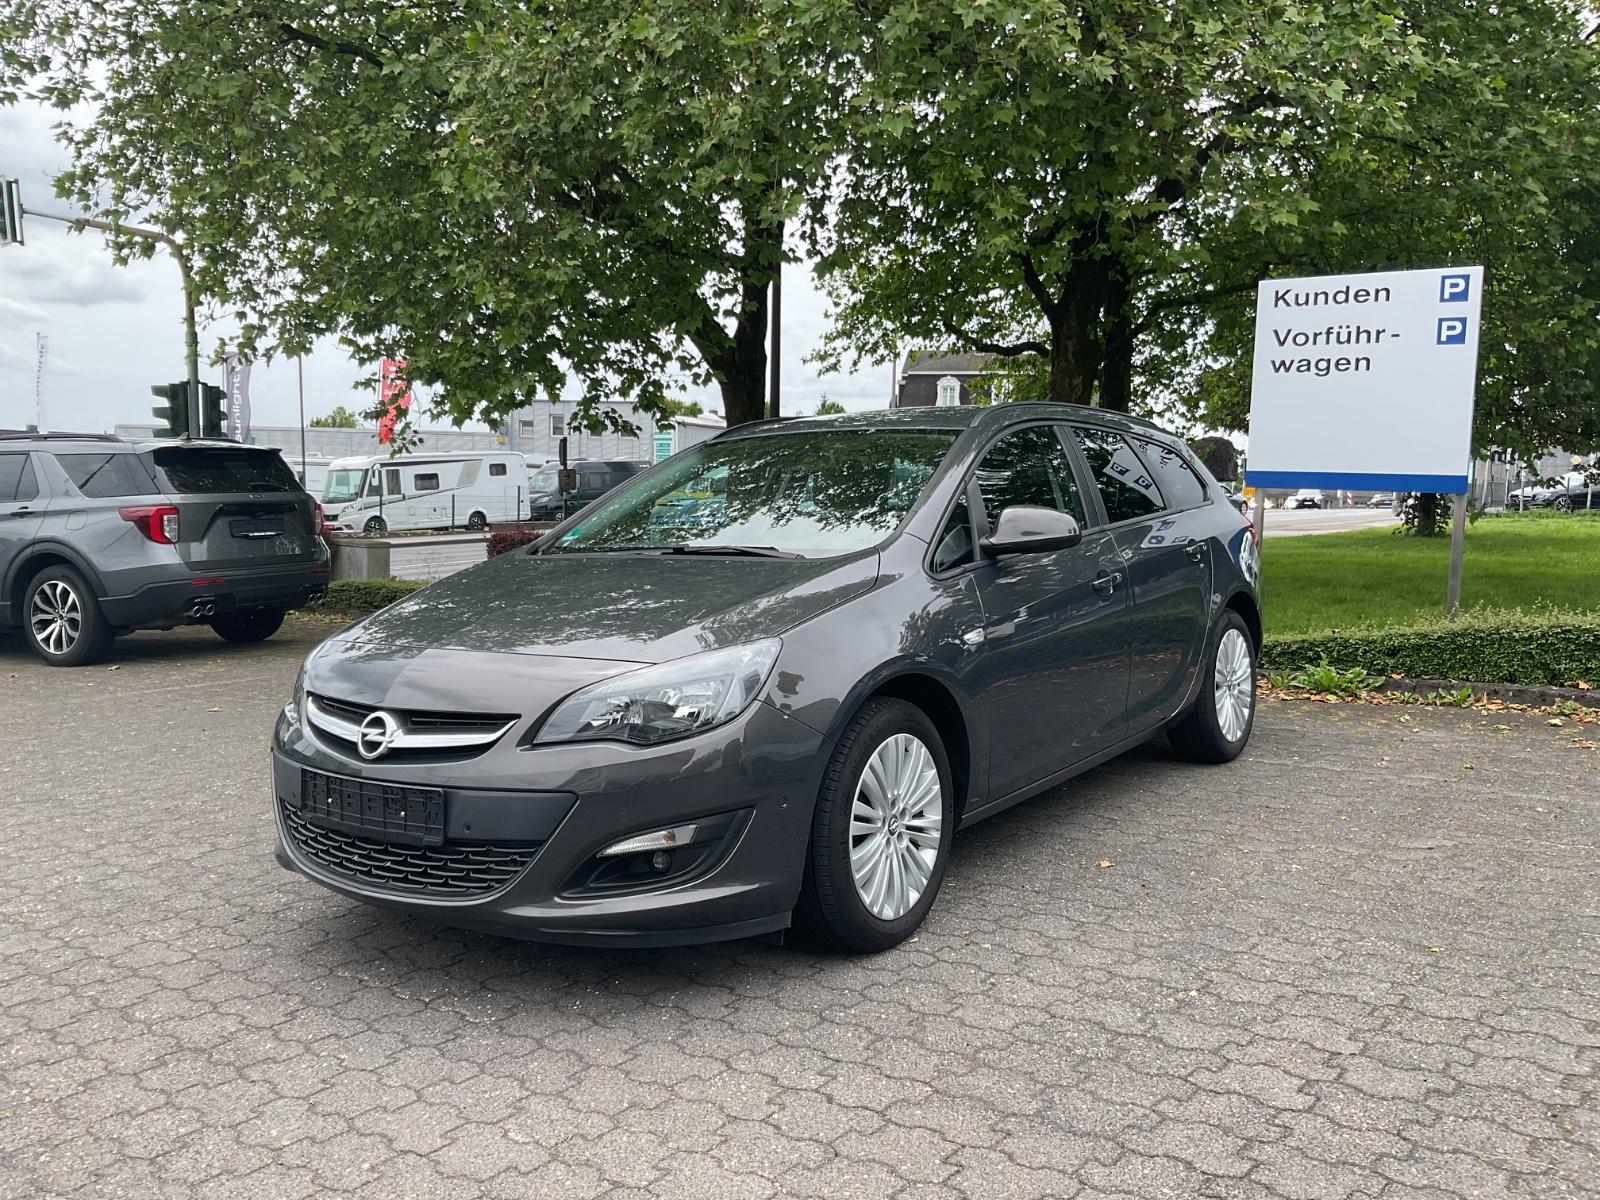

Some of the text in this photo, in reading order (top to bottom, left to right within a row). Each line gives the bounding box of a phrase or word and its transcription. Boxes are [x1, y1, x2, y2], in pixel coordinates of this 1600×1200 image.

[1273, 277, 1466, 308] Kunden P
[1272, 320, 1463, 348] Vorführ- P
[1270, 355, 1371, 377] wagen
[232, 374, 243, 443] sunlight
